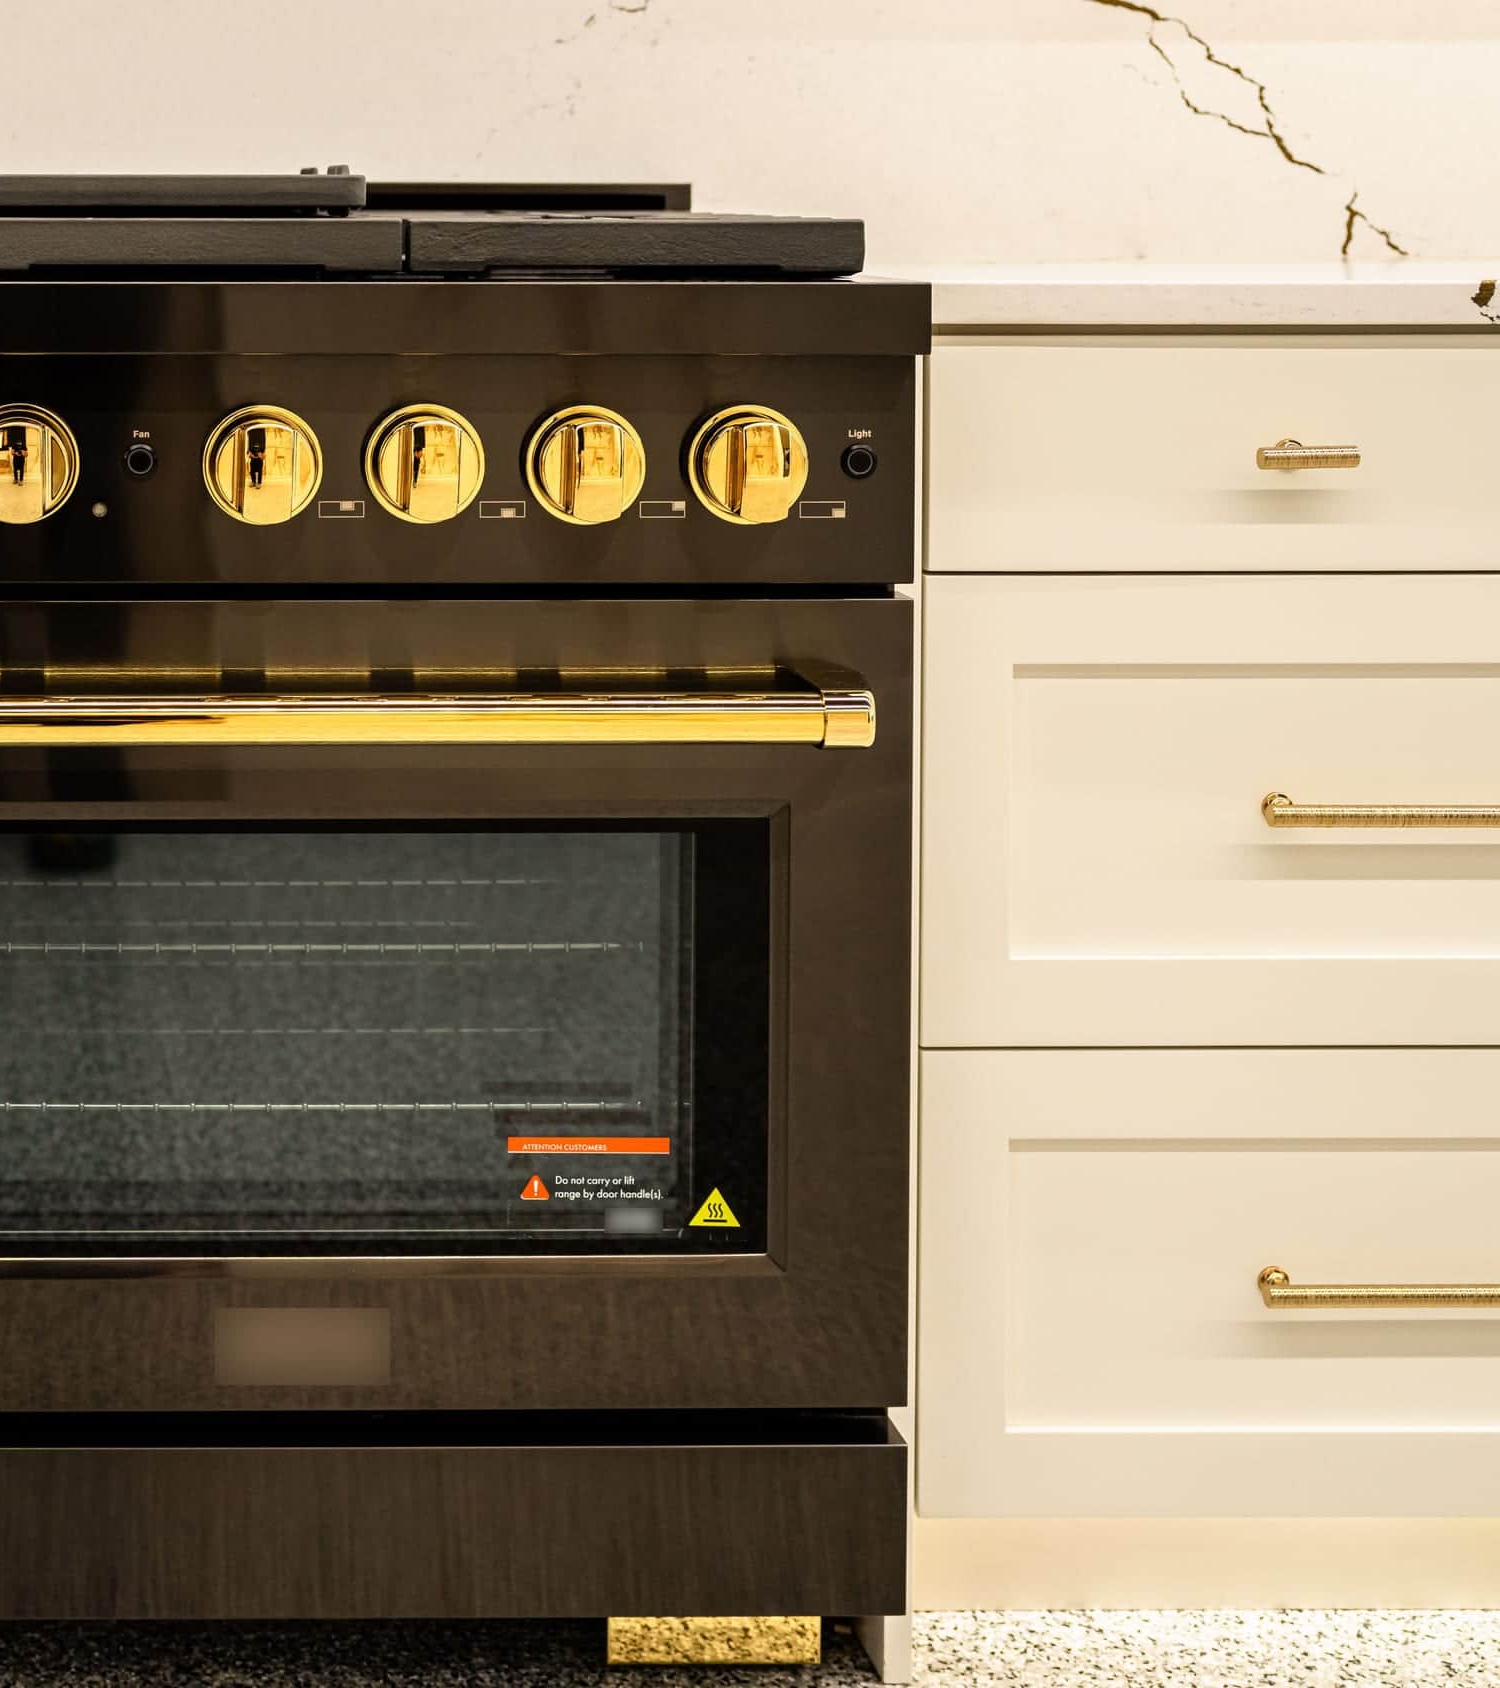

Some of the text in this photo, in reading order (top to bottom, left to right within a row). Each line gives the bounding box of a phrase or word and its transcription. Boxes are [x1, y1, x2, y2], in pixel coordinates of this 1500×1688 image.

[132, 429, 151, 439] Fan
[847, 429, 872, 440] Light
[521, 1143, 608, 1151] ATTENTION CUSTOMERS
[555, 1175, 635, 1187] Do not carry or lift
[554, 1190, 581, 1200] range
[583, 1188, 595, 1200] by
[596, 1188, 618, 1199] door
